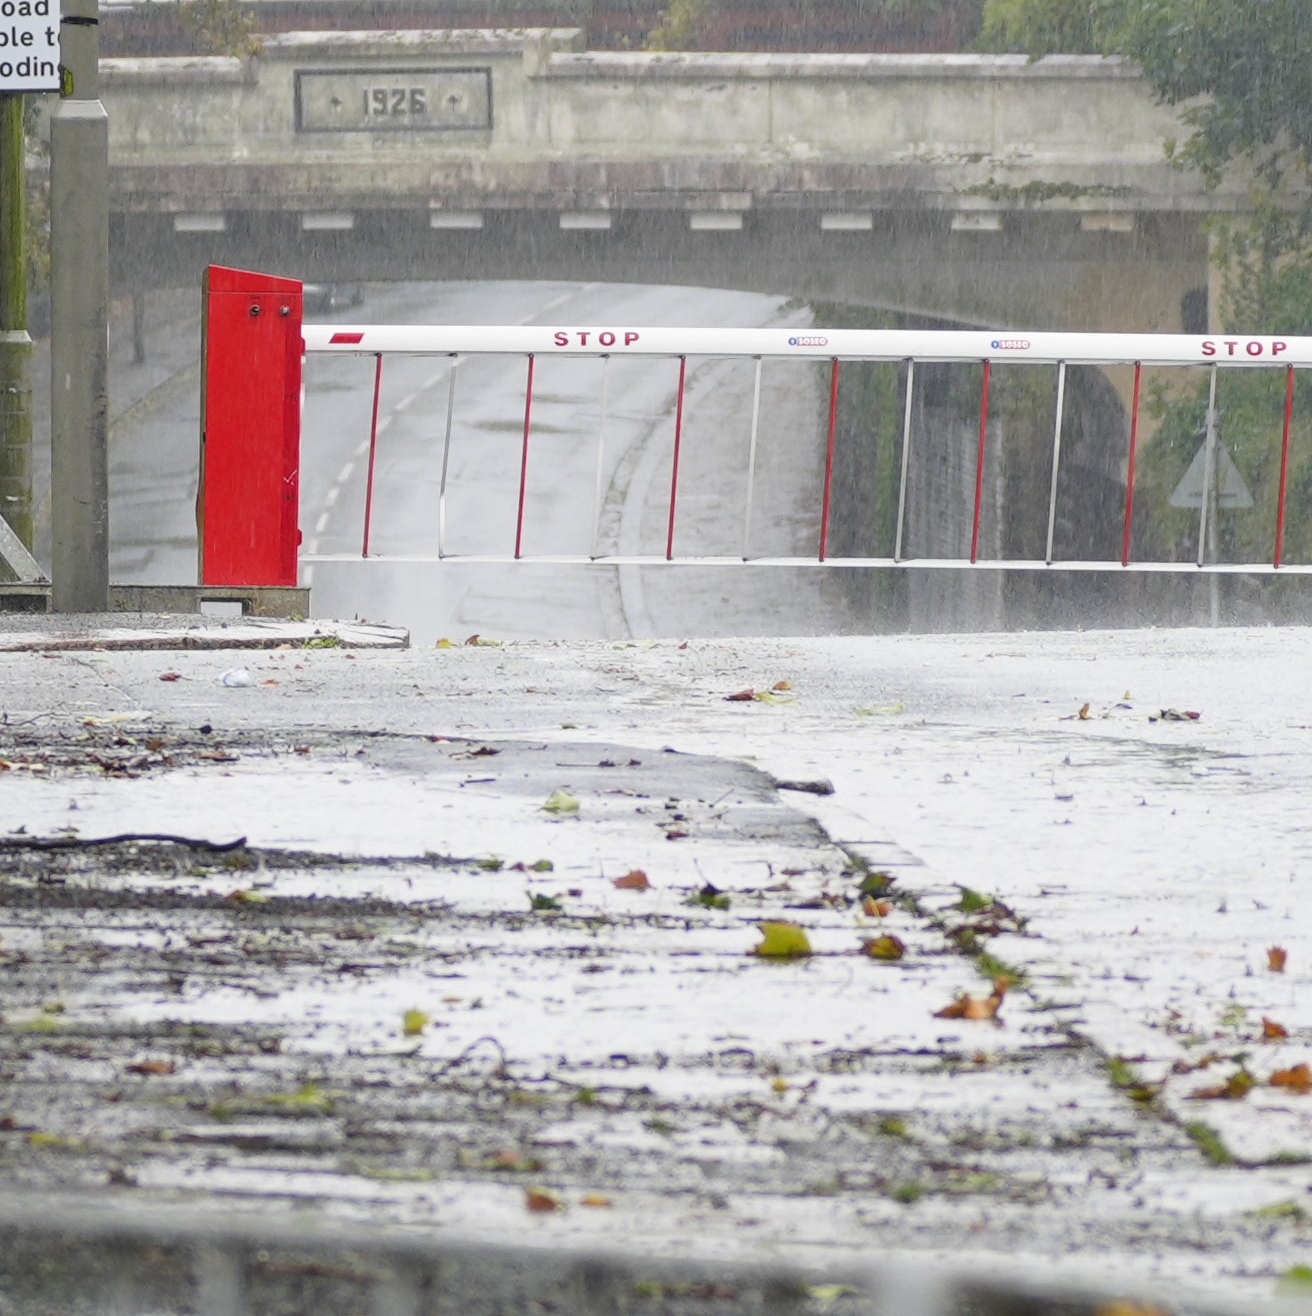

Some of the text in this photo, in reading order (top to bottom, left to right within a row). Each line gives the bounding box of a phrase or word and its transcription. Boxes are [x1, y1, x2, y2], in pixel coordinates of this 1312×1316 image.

[363, 88, 426, 115] 1926
[553, 331, 640, 347] STOP
[1201, 341, 1287, 356] STOP
